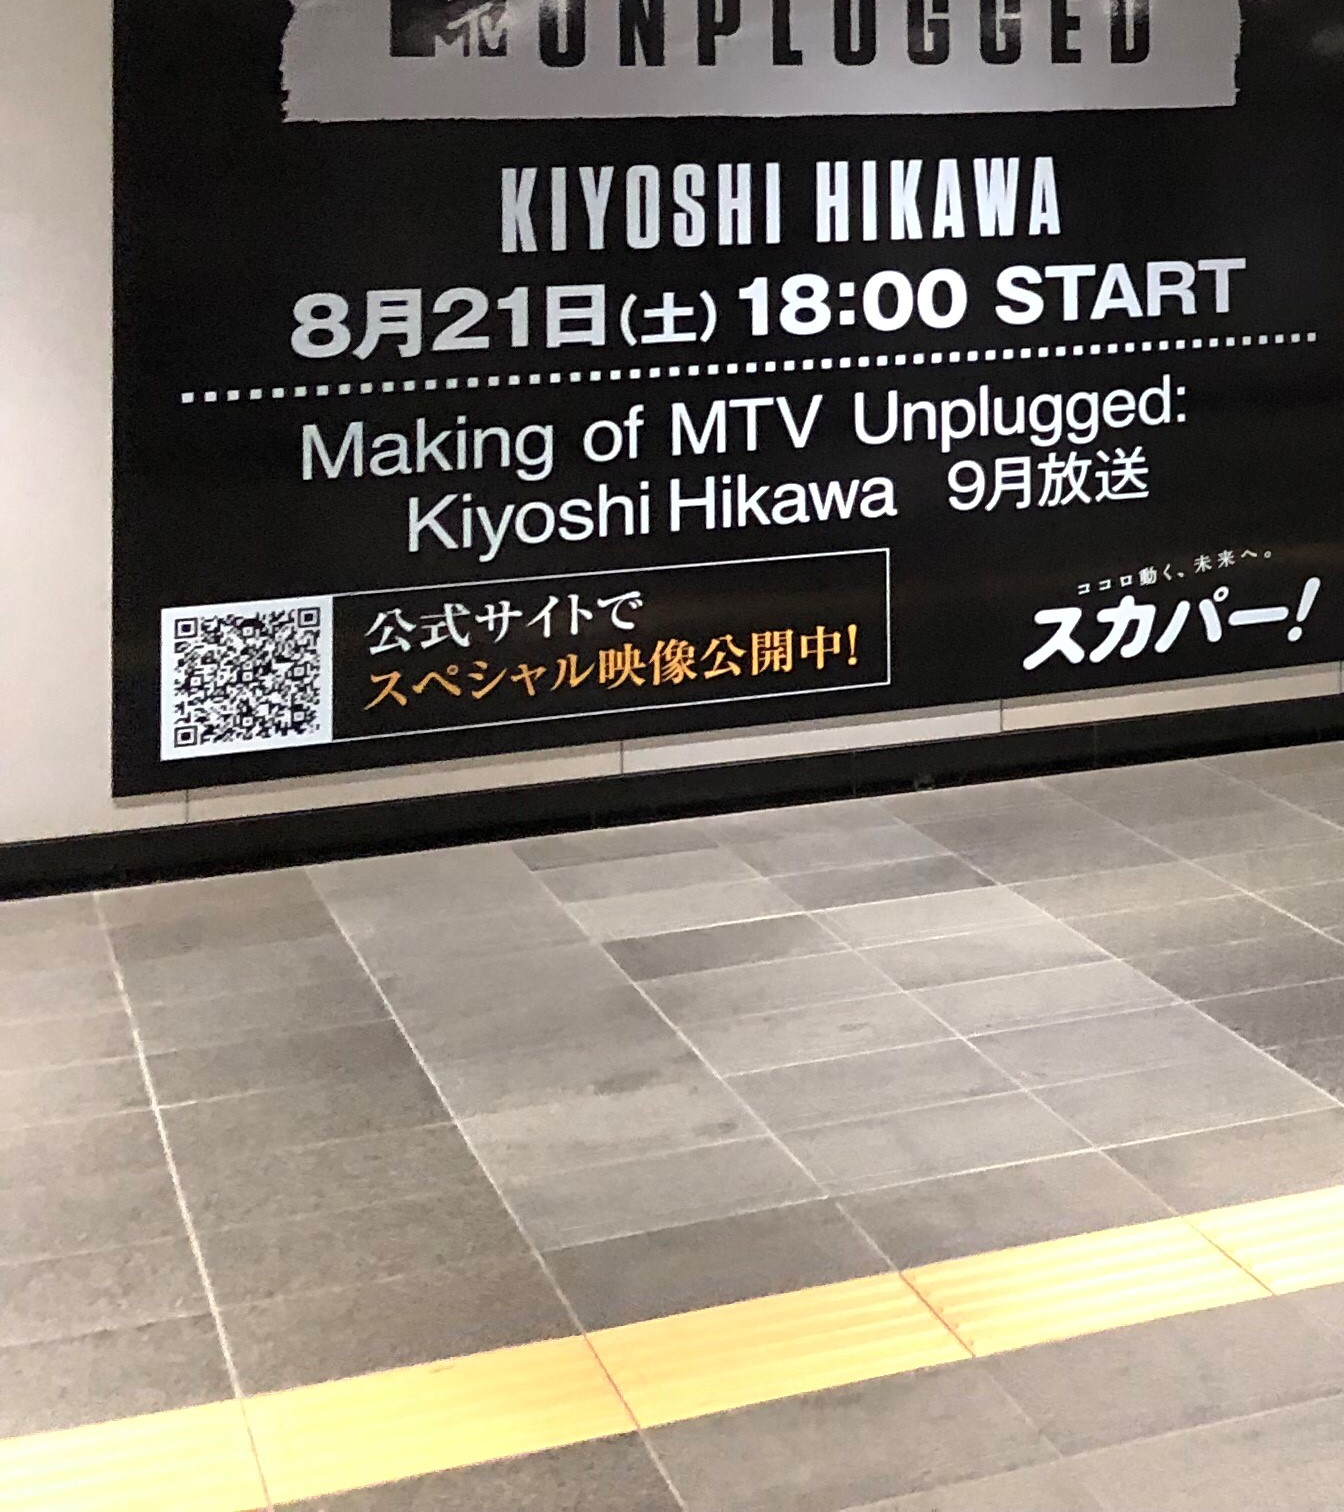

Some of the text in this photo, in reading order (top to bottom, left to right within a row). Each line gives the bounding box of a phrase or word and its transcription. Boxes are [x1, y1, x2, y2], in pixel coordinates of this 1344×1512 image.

[501, 156, 1061, 253] KIYOSHI HIKAWA
[738, 268, 968, 336] 18:00
[994, 257, 1247, 326] START
[302, 374, 1188, 481] Making of MTV Unplugged:
[408, 446, 1150, 562] Kiyoshi Hikawa 9月放送
[1077, 550, 1272, 595] ココロ動く、未来へ。
[362, 623, 859, 710] スペシャル映像公開中!
[363, 590, 644, 656] 公式サイトで
[1022, 576, 1321, 670] スカパー!
